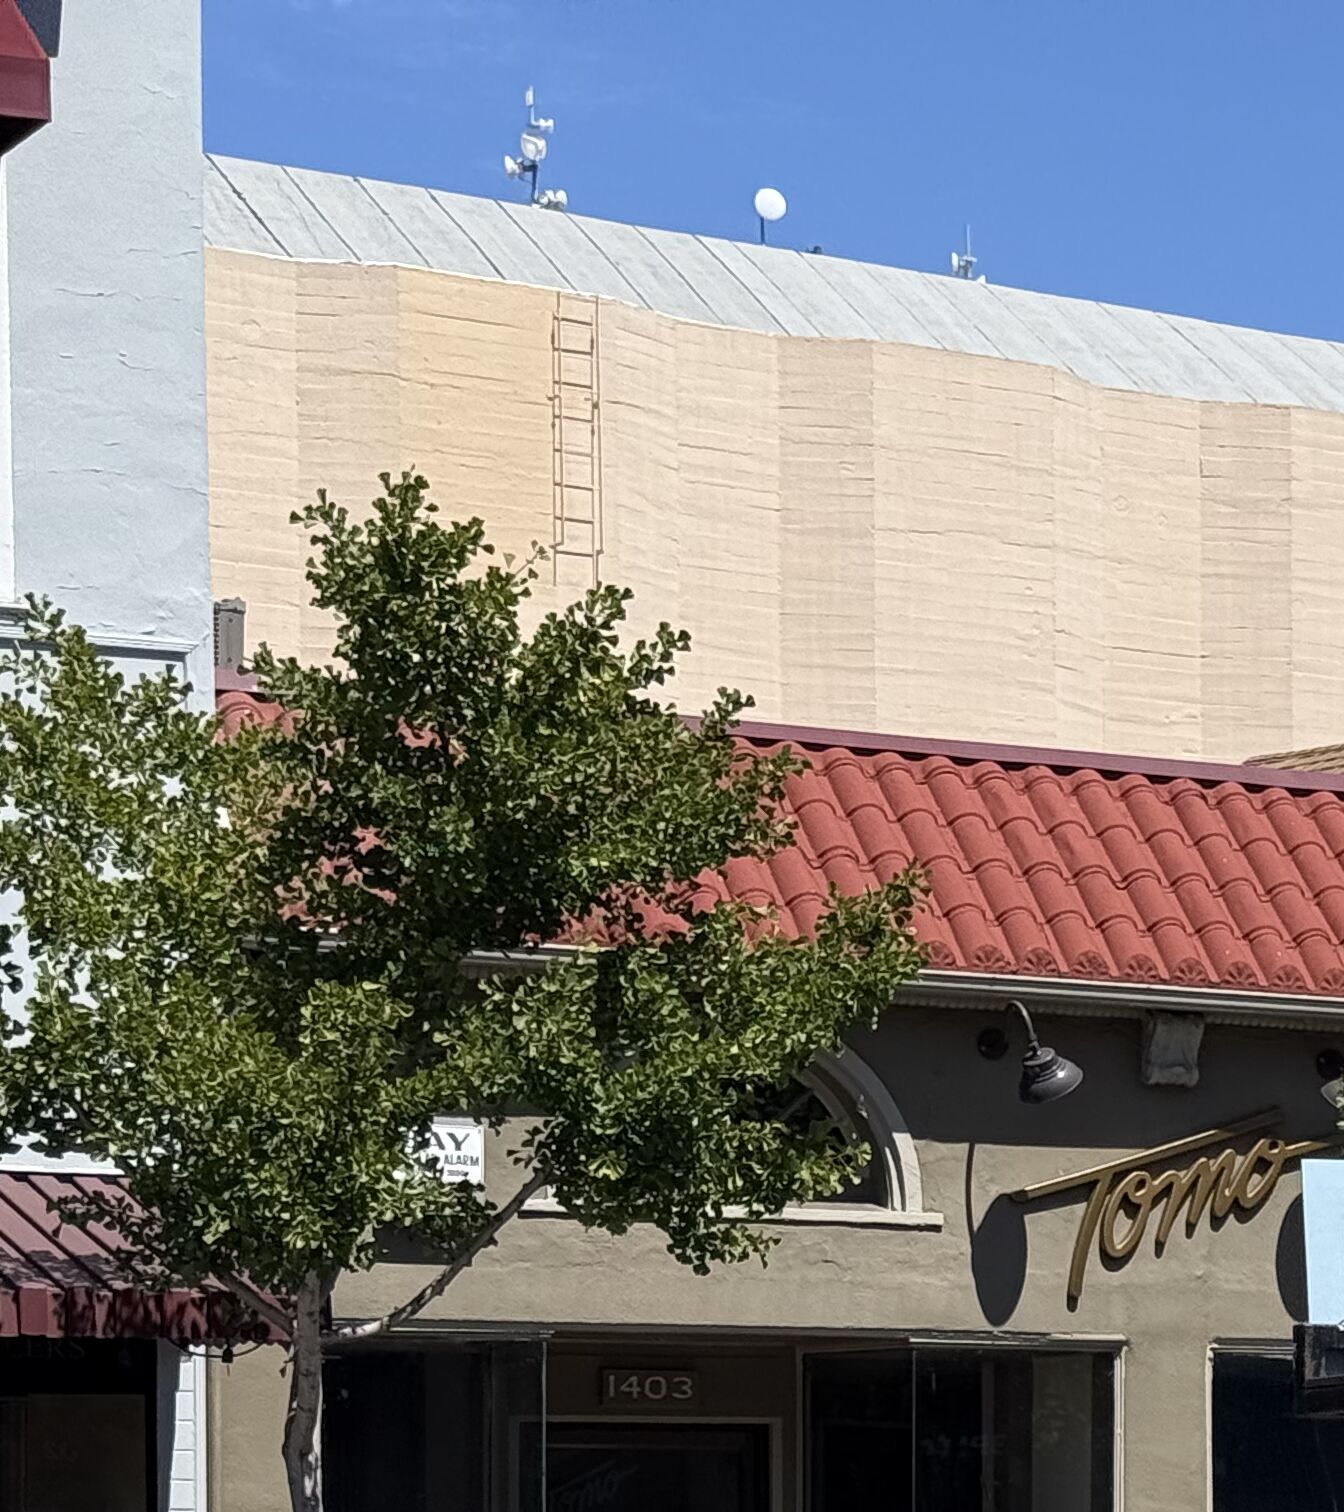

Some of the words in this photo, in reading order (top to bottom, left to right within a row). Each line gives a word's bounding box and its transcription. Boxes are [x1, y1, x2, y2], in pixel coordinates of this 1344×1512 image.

[444, 1154, 479, 1167] ALARM
[1023, 1105, 1333, 1298] Tomo
[607, 1374, 694, 1399] 1403
